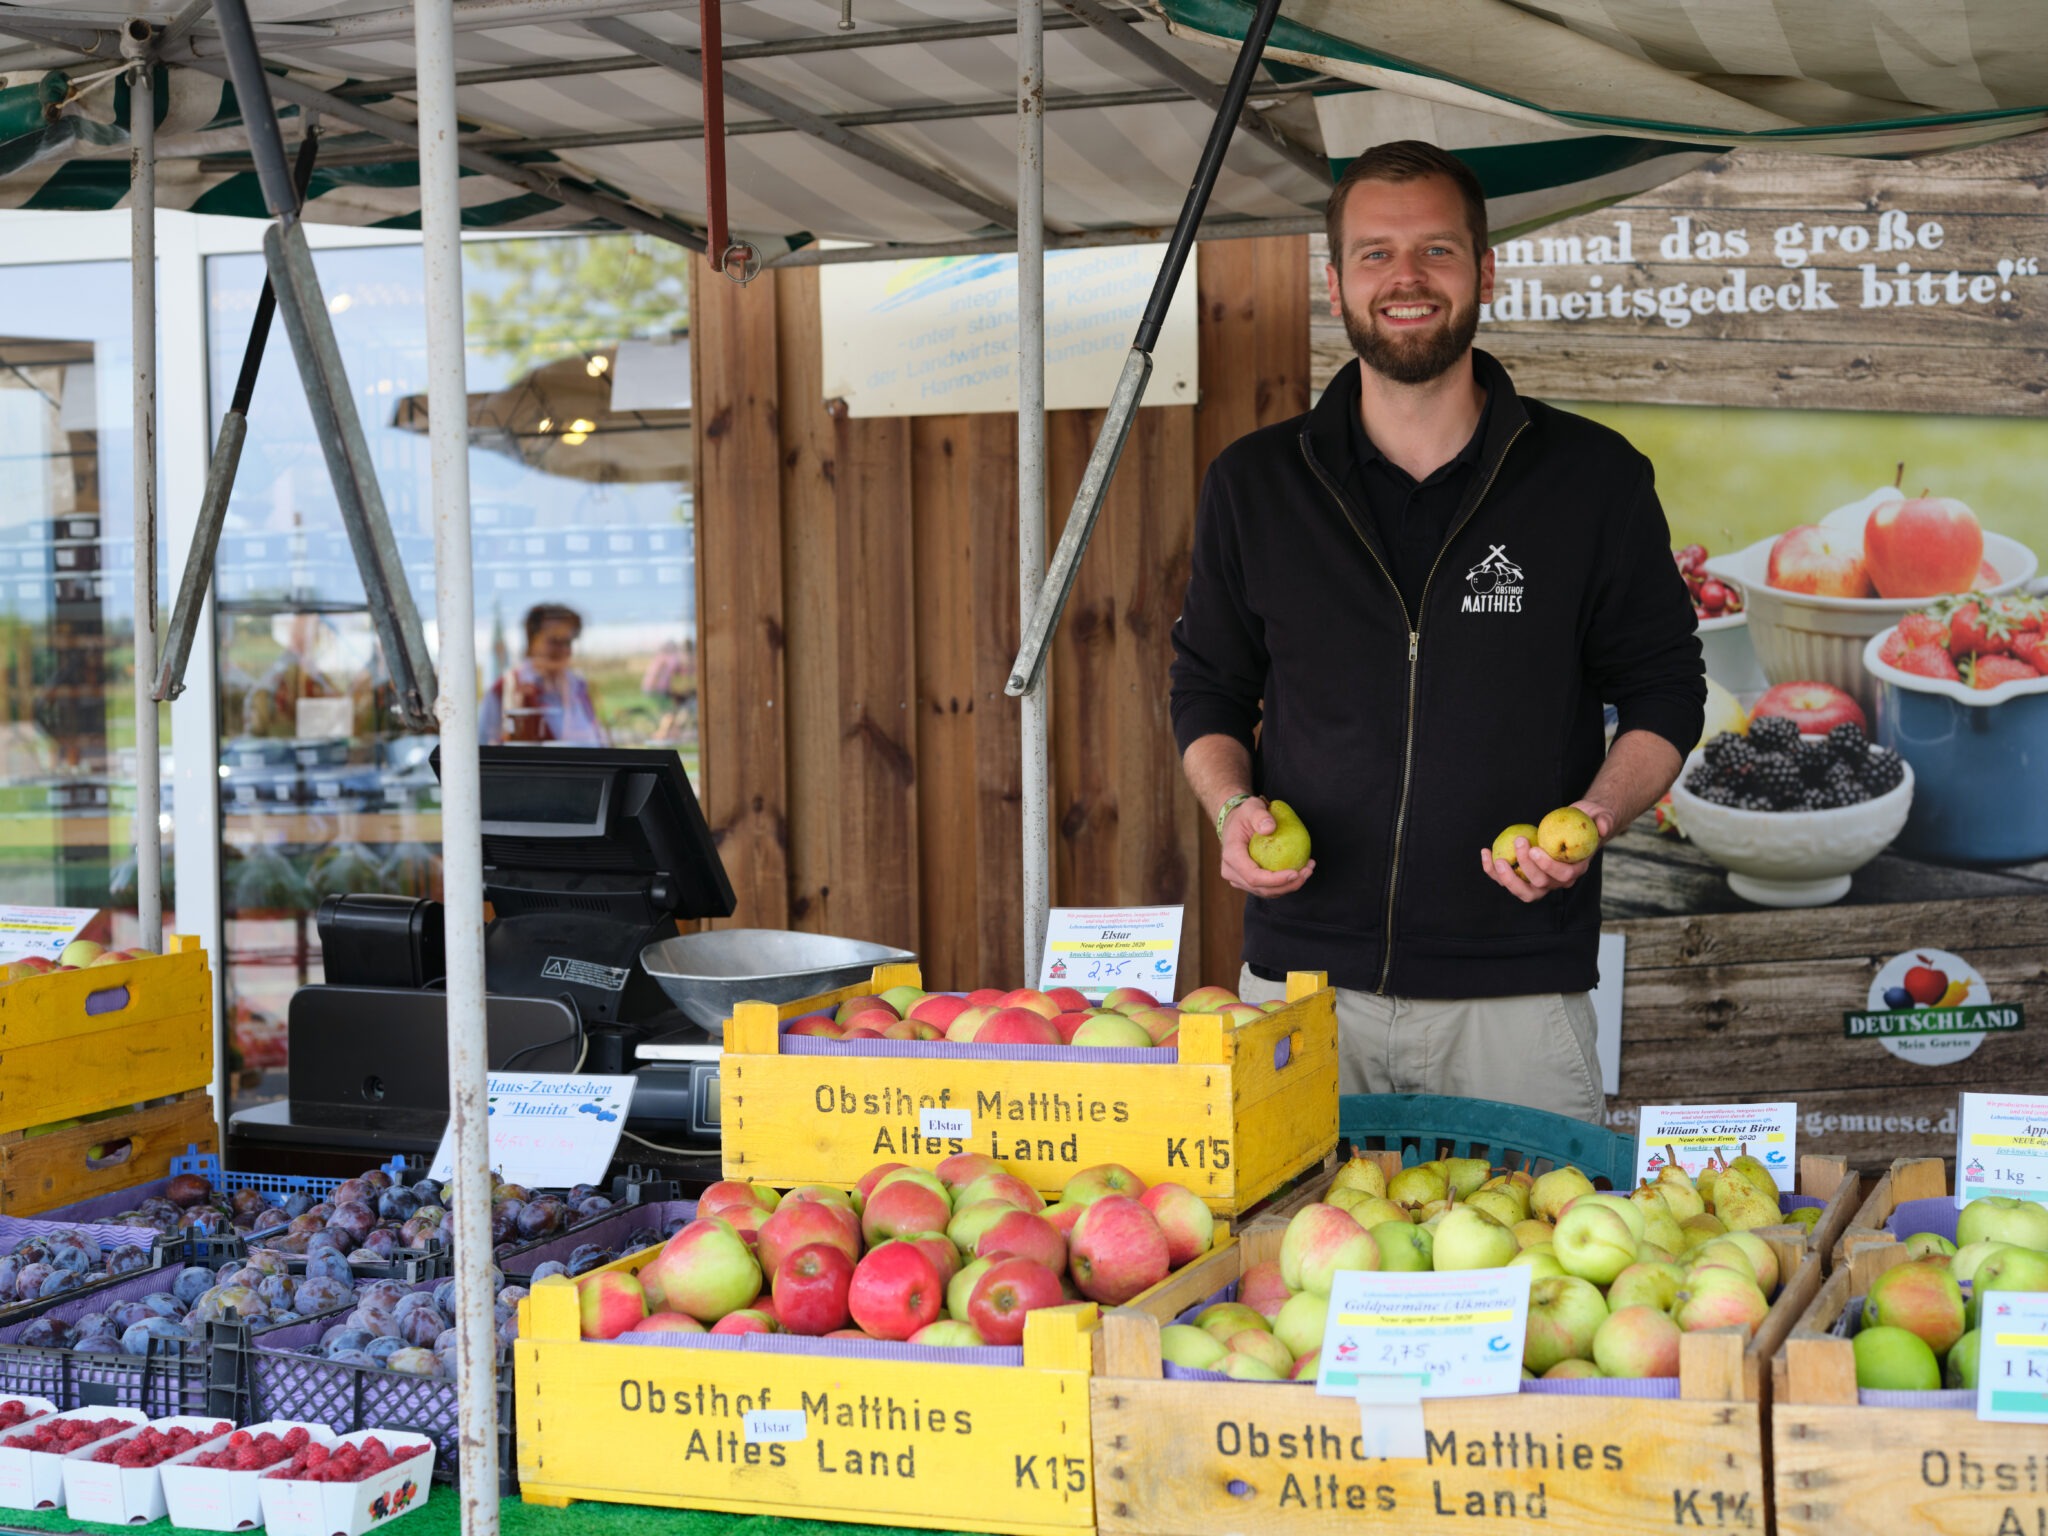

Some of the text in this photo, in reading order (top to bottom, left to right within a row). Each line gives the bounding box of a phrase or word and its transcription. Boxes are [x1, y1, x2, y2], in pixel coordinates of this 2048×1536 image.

[1660, 215, 1750, 262] das
[1773, 209, 1945, 268] große
[1495, 585, 1524, 595] OBSTHOF
[1461, 595, 1522, 613] MATTHIES
[1101, 930, 1132, 940] Elstar
[1087, 960, 1132, 982] 2,75
[1850, 1009, 2019, 1035] DEUTSCHLAND
[1898, 1038, 1971, 1050] Mein Garten
[486, 1079, 613, 1096] Haus-Zwetschen
[815, 1084, 1130, 1123] Obsthof Matthies
[929, 1119, 963, 1131] Elstar
[1712, 1125, 1747, 1134] Christ
[1749, 1124, 1781, 1133] Birne
[873, 1126, 1231, 1170] Altes Land K15
[2007, 1168, 2025, 1185] kg
[1344, 1299, 1439, 1314] Goldparmäne
[619, 1379, 973, 1434] Obsthof Matthies
[753, 1422, 792, 1434] Elstar
[1216, 1421, 1625, 1471] Obstho Matthies
[684, 1429, 1086, 1493] Altes Land K15
[1278, 1473, 1397, 1511] Altes
[1433, 1480, 1548, 1519] Land
